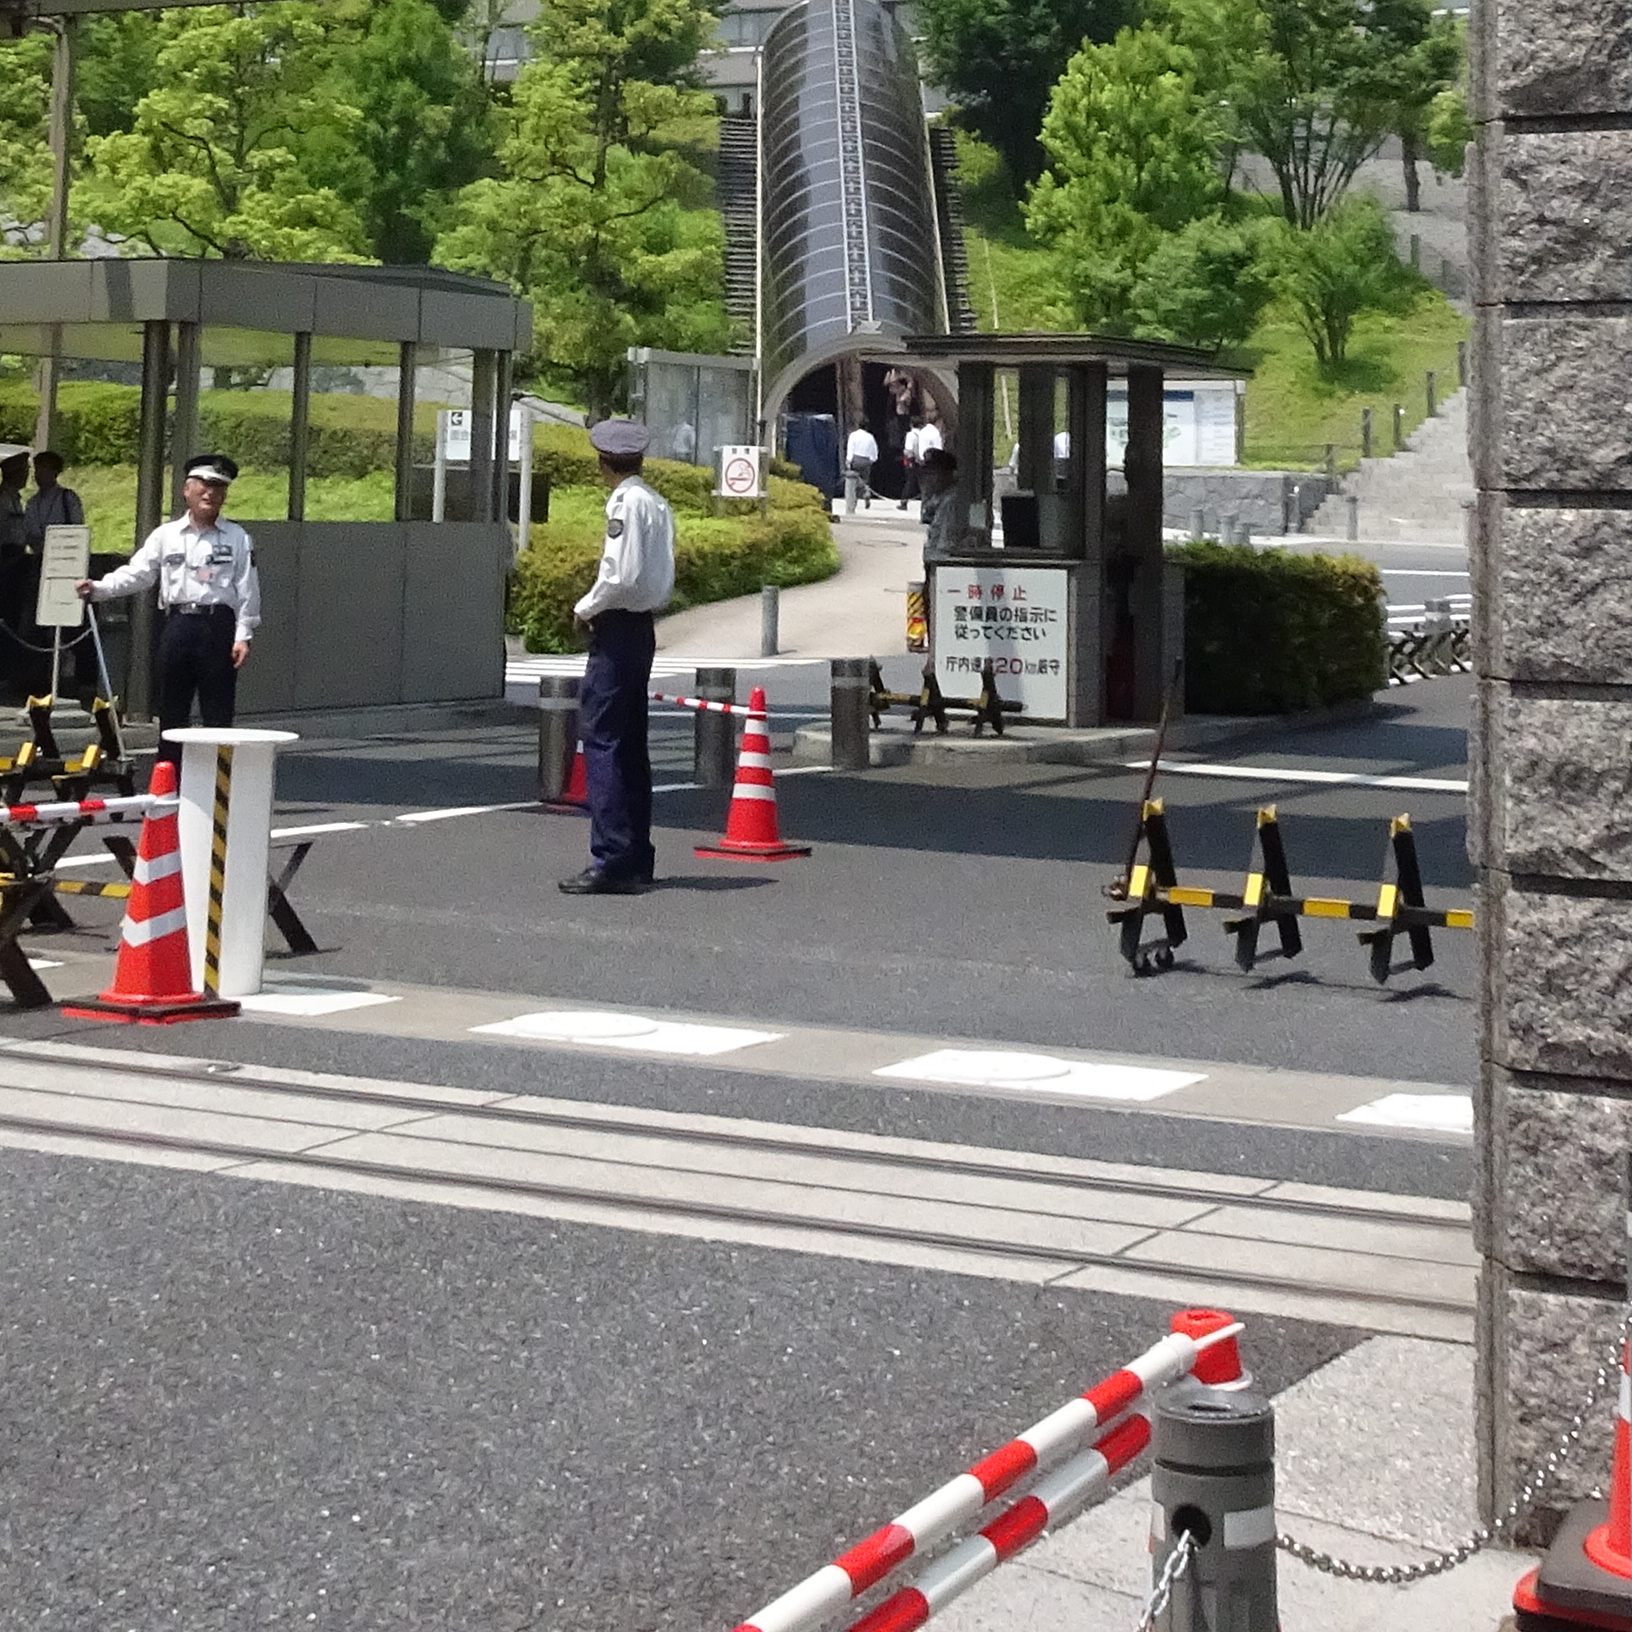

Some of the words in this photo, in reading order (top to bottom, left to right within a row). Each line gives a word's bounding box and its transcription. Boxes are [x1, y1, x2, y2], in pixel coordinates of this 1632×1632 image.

[947, 584, 1028, 601] 一時停止
[954, 606, 1058, 623] 警備員の指示に
[955, 624, 1047, 641] 従ってください
